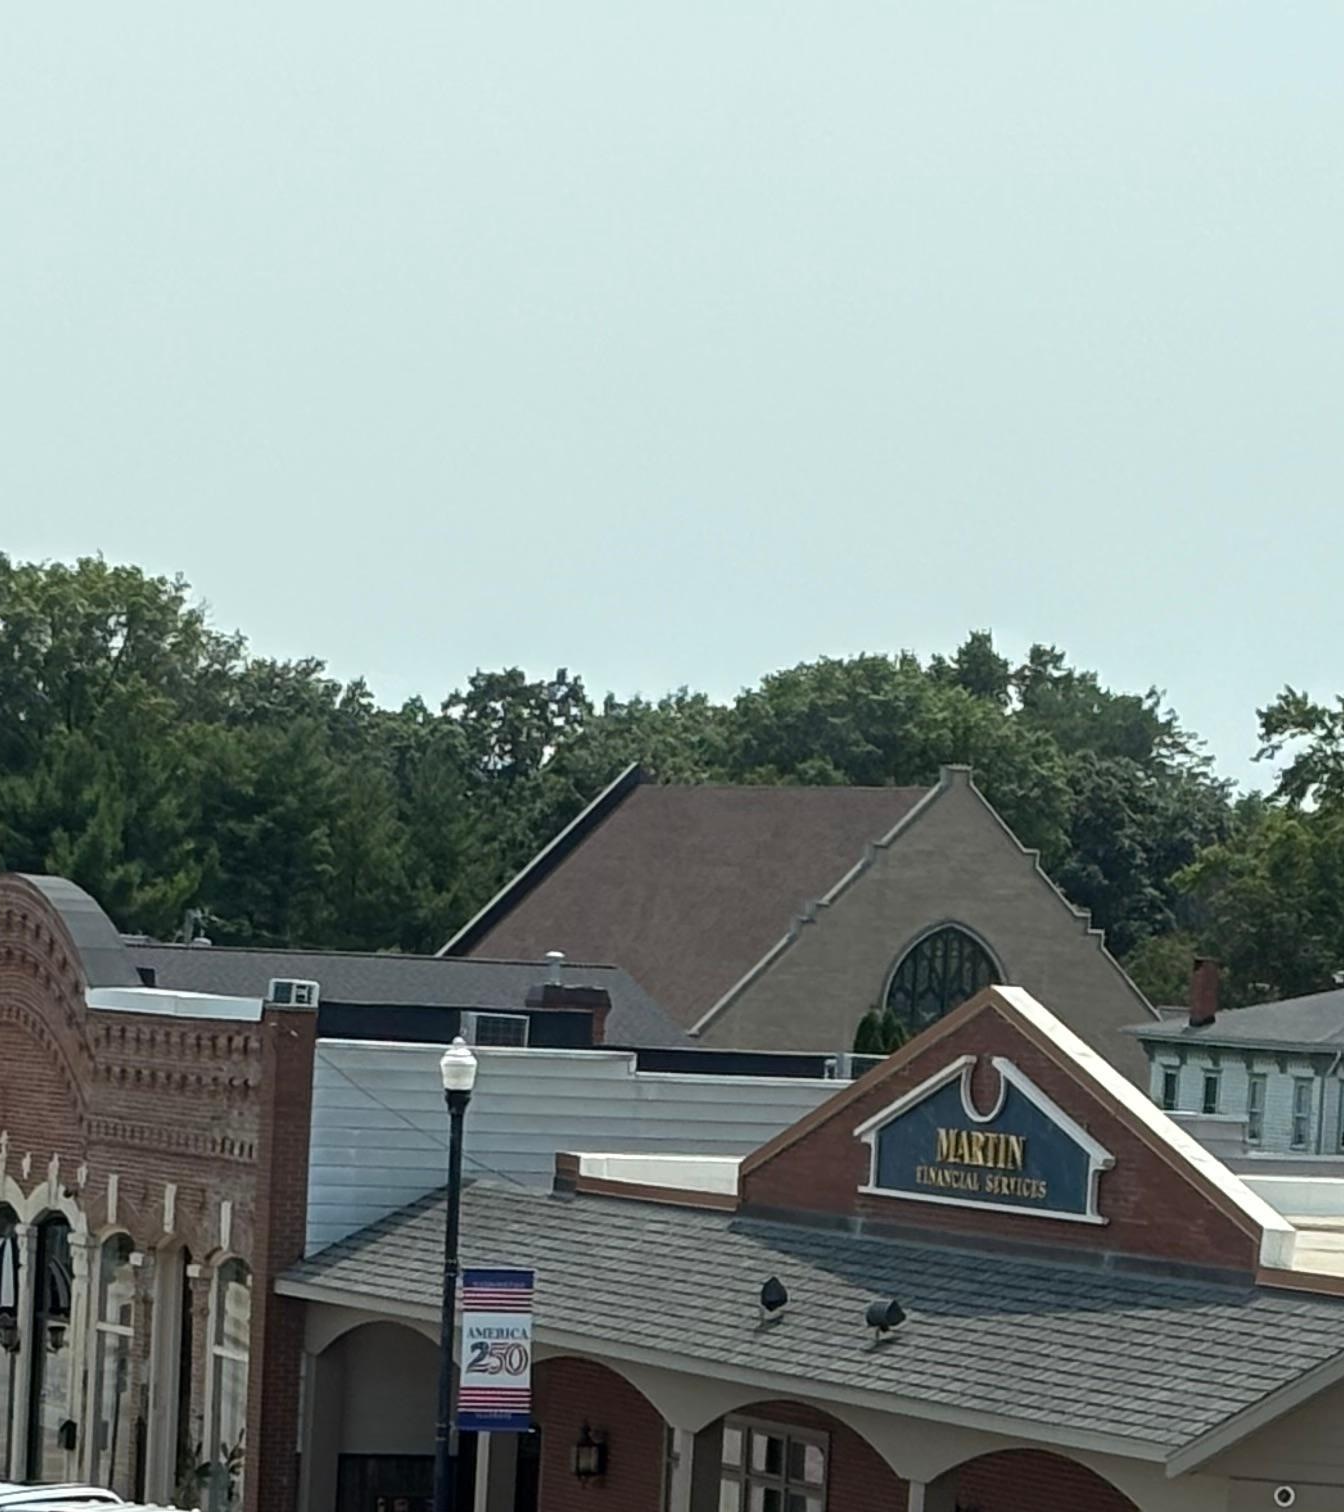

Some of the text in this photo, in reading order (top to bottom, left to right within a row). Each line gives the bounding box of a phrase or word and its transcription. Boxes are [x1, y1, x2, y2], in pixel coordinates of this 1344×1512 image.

[936, 1127, 1027, 1171] MARTIN
[915, 1165, 1048, 1200] FINANCIAL SERVICES
[467, 1327, 529, 1341] AMERICA
[465, 1341, 529, 1377] 250
